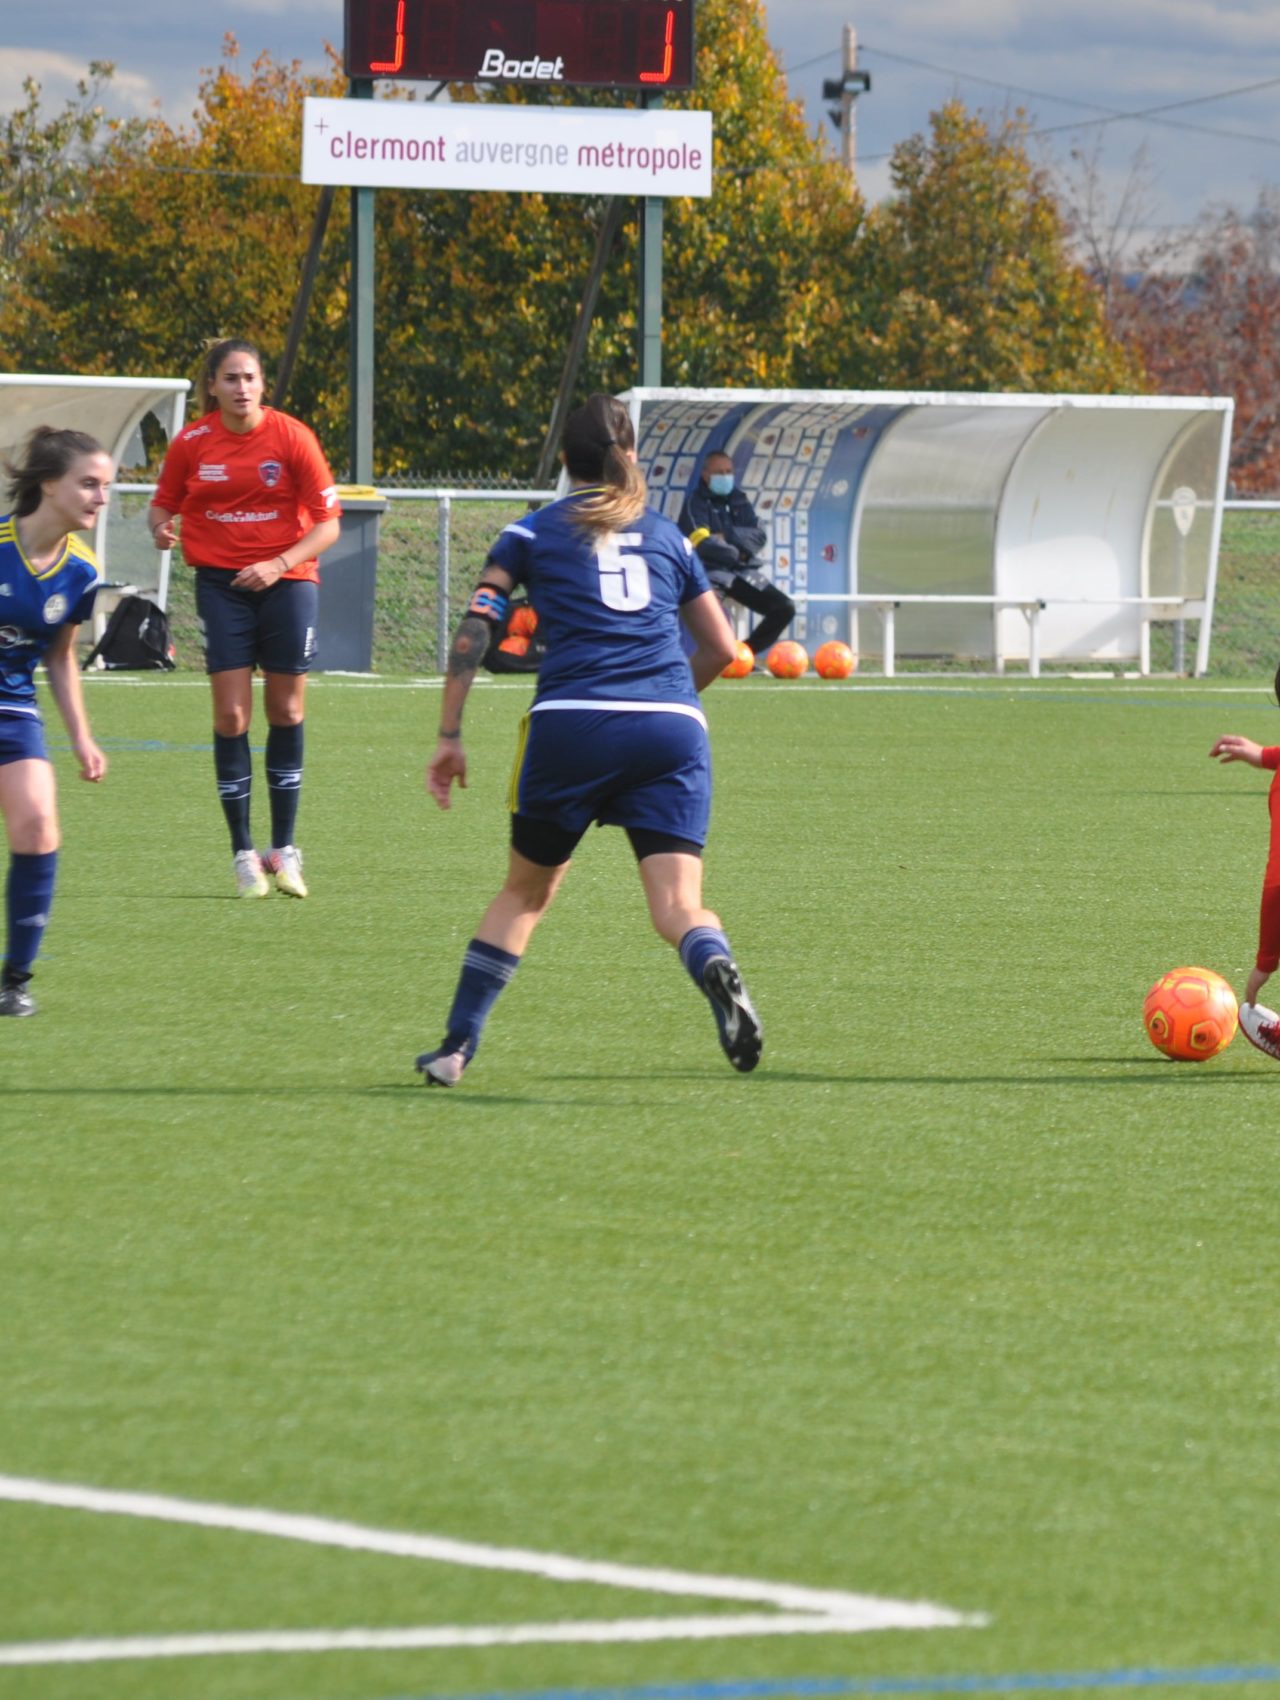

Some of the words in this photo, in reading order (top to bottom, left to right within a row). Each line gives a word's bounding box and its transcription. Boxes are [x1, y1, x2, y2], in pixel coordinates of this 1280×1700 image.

[478, 49, 563, 79] Bodet
[330, 131, 446, 162] clermont
[455, 141, 568, 167] auvergne
[577, 141, 702, 176] métropole
[597, 532, 652, 611] 5
